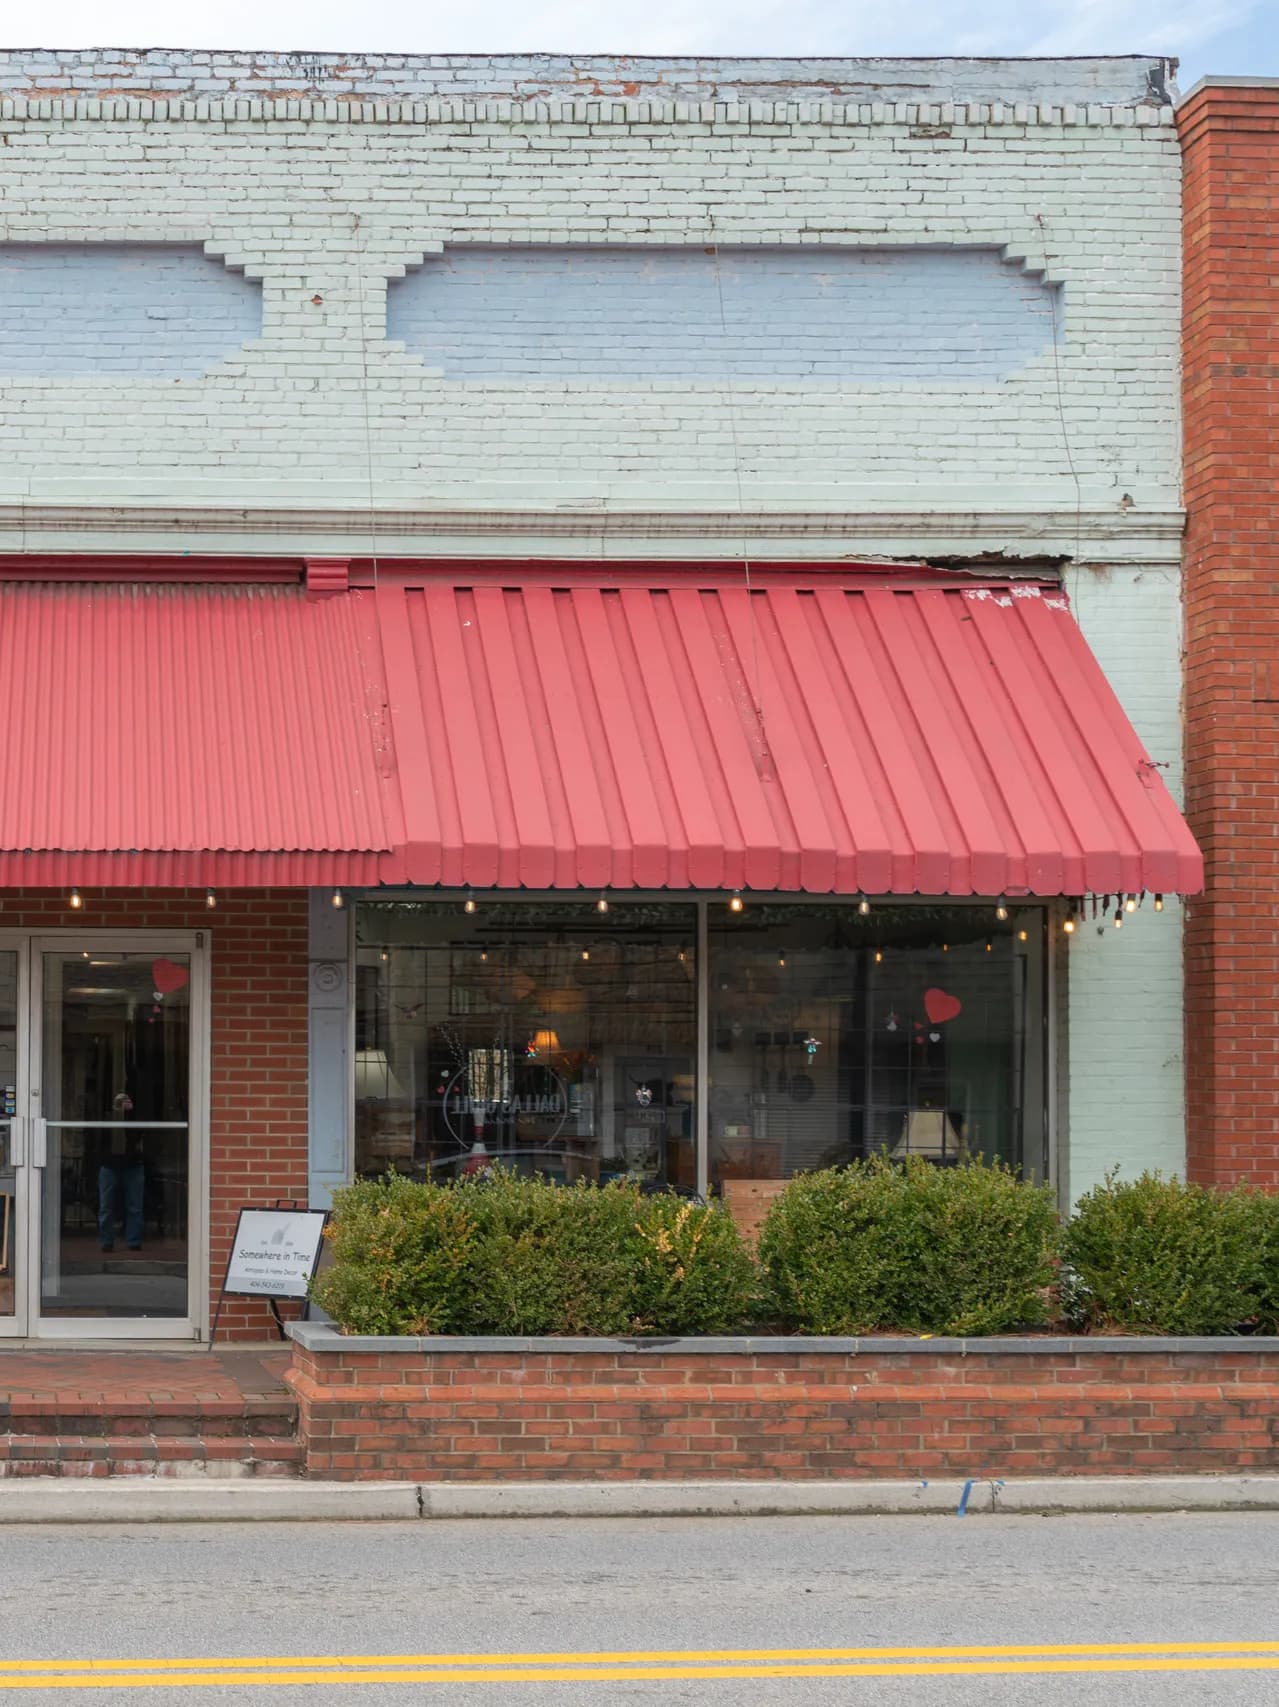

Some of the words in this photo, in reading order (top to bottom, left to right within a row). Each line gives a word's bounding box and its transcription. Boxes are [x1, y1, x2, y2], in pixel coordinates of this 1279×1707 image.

[239, 1249, 282, 1261] Somewhere
[283, 1251, 291, 1261] in
[293, 1252, 311, 1262] Time
